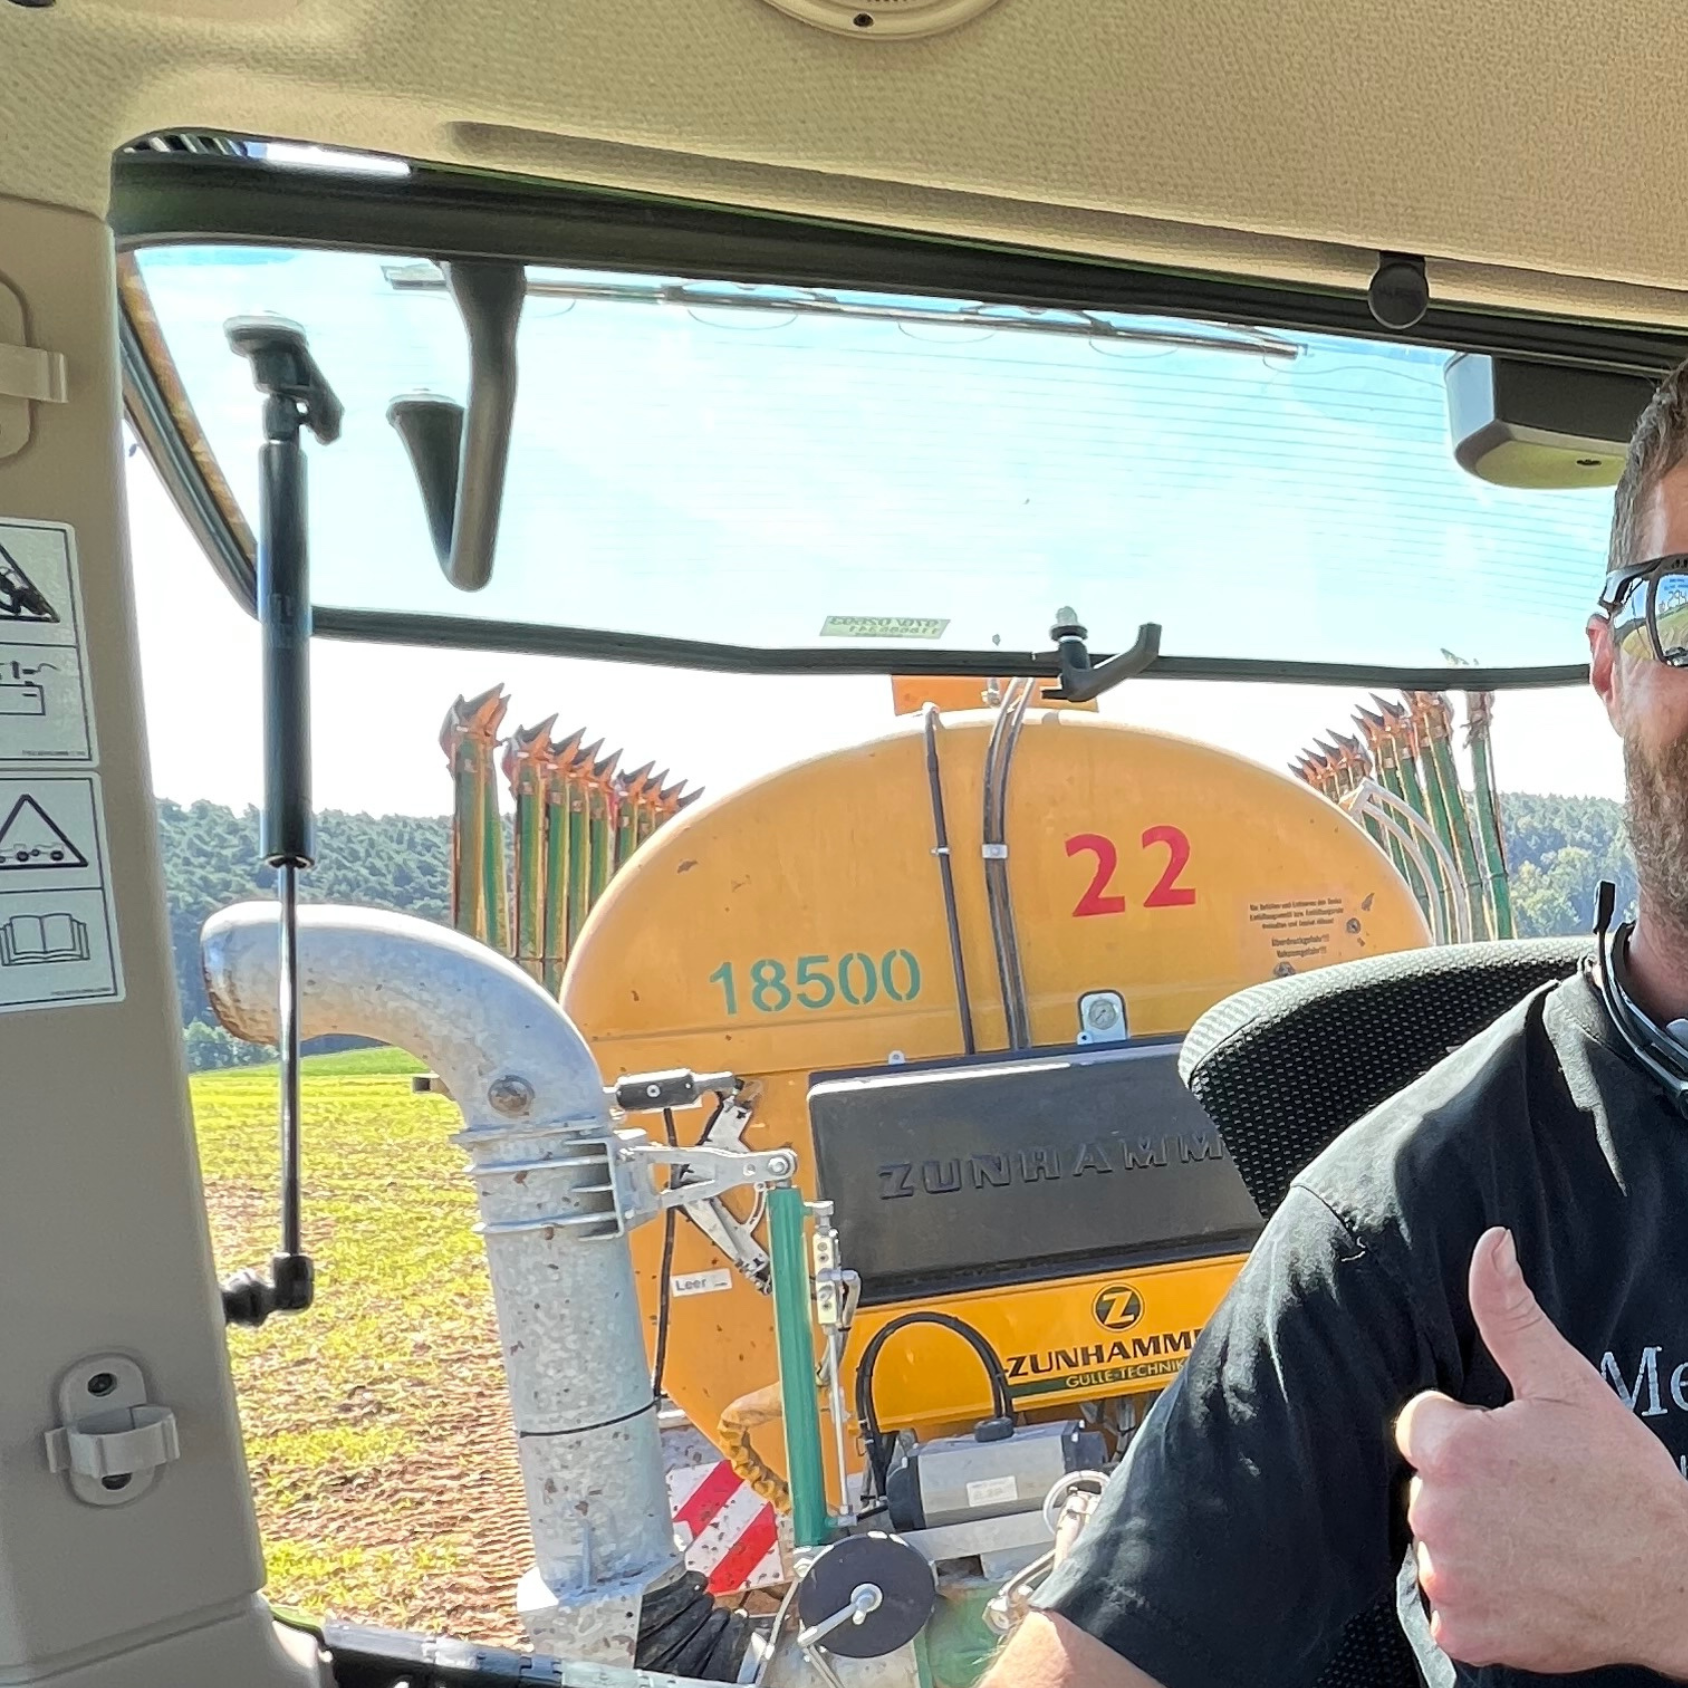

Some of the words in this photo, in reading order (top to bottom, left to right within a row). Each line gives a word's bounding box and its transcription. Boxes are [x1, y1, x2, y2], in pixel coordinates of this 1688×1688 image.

[1064, 825, 1197, 918] 22
[709, 948, 922, 1016] 18500
[675, 1279, 706, 1291] Leer
[1006, 1327, 1203, 1378] ZUNHAMM
